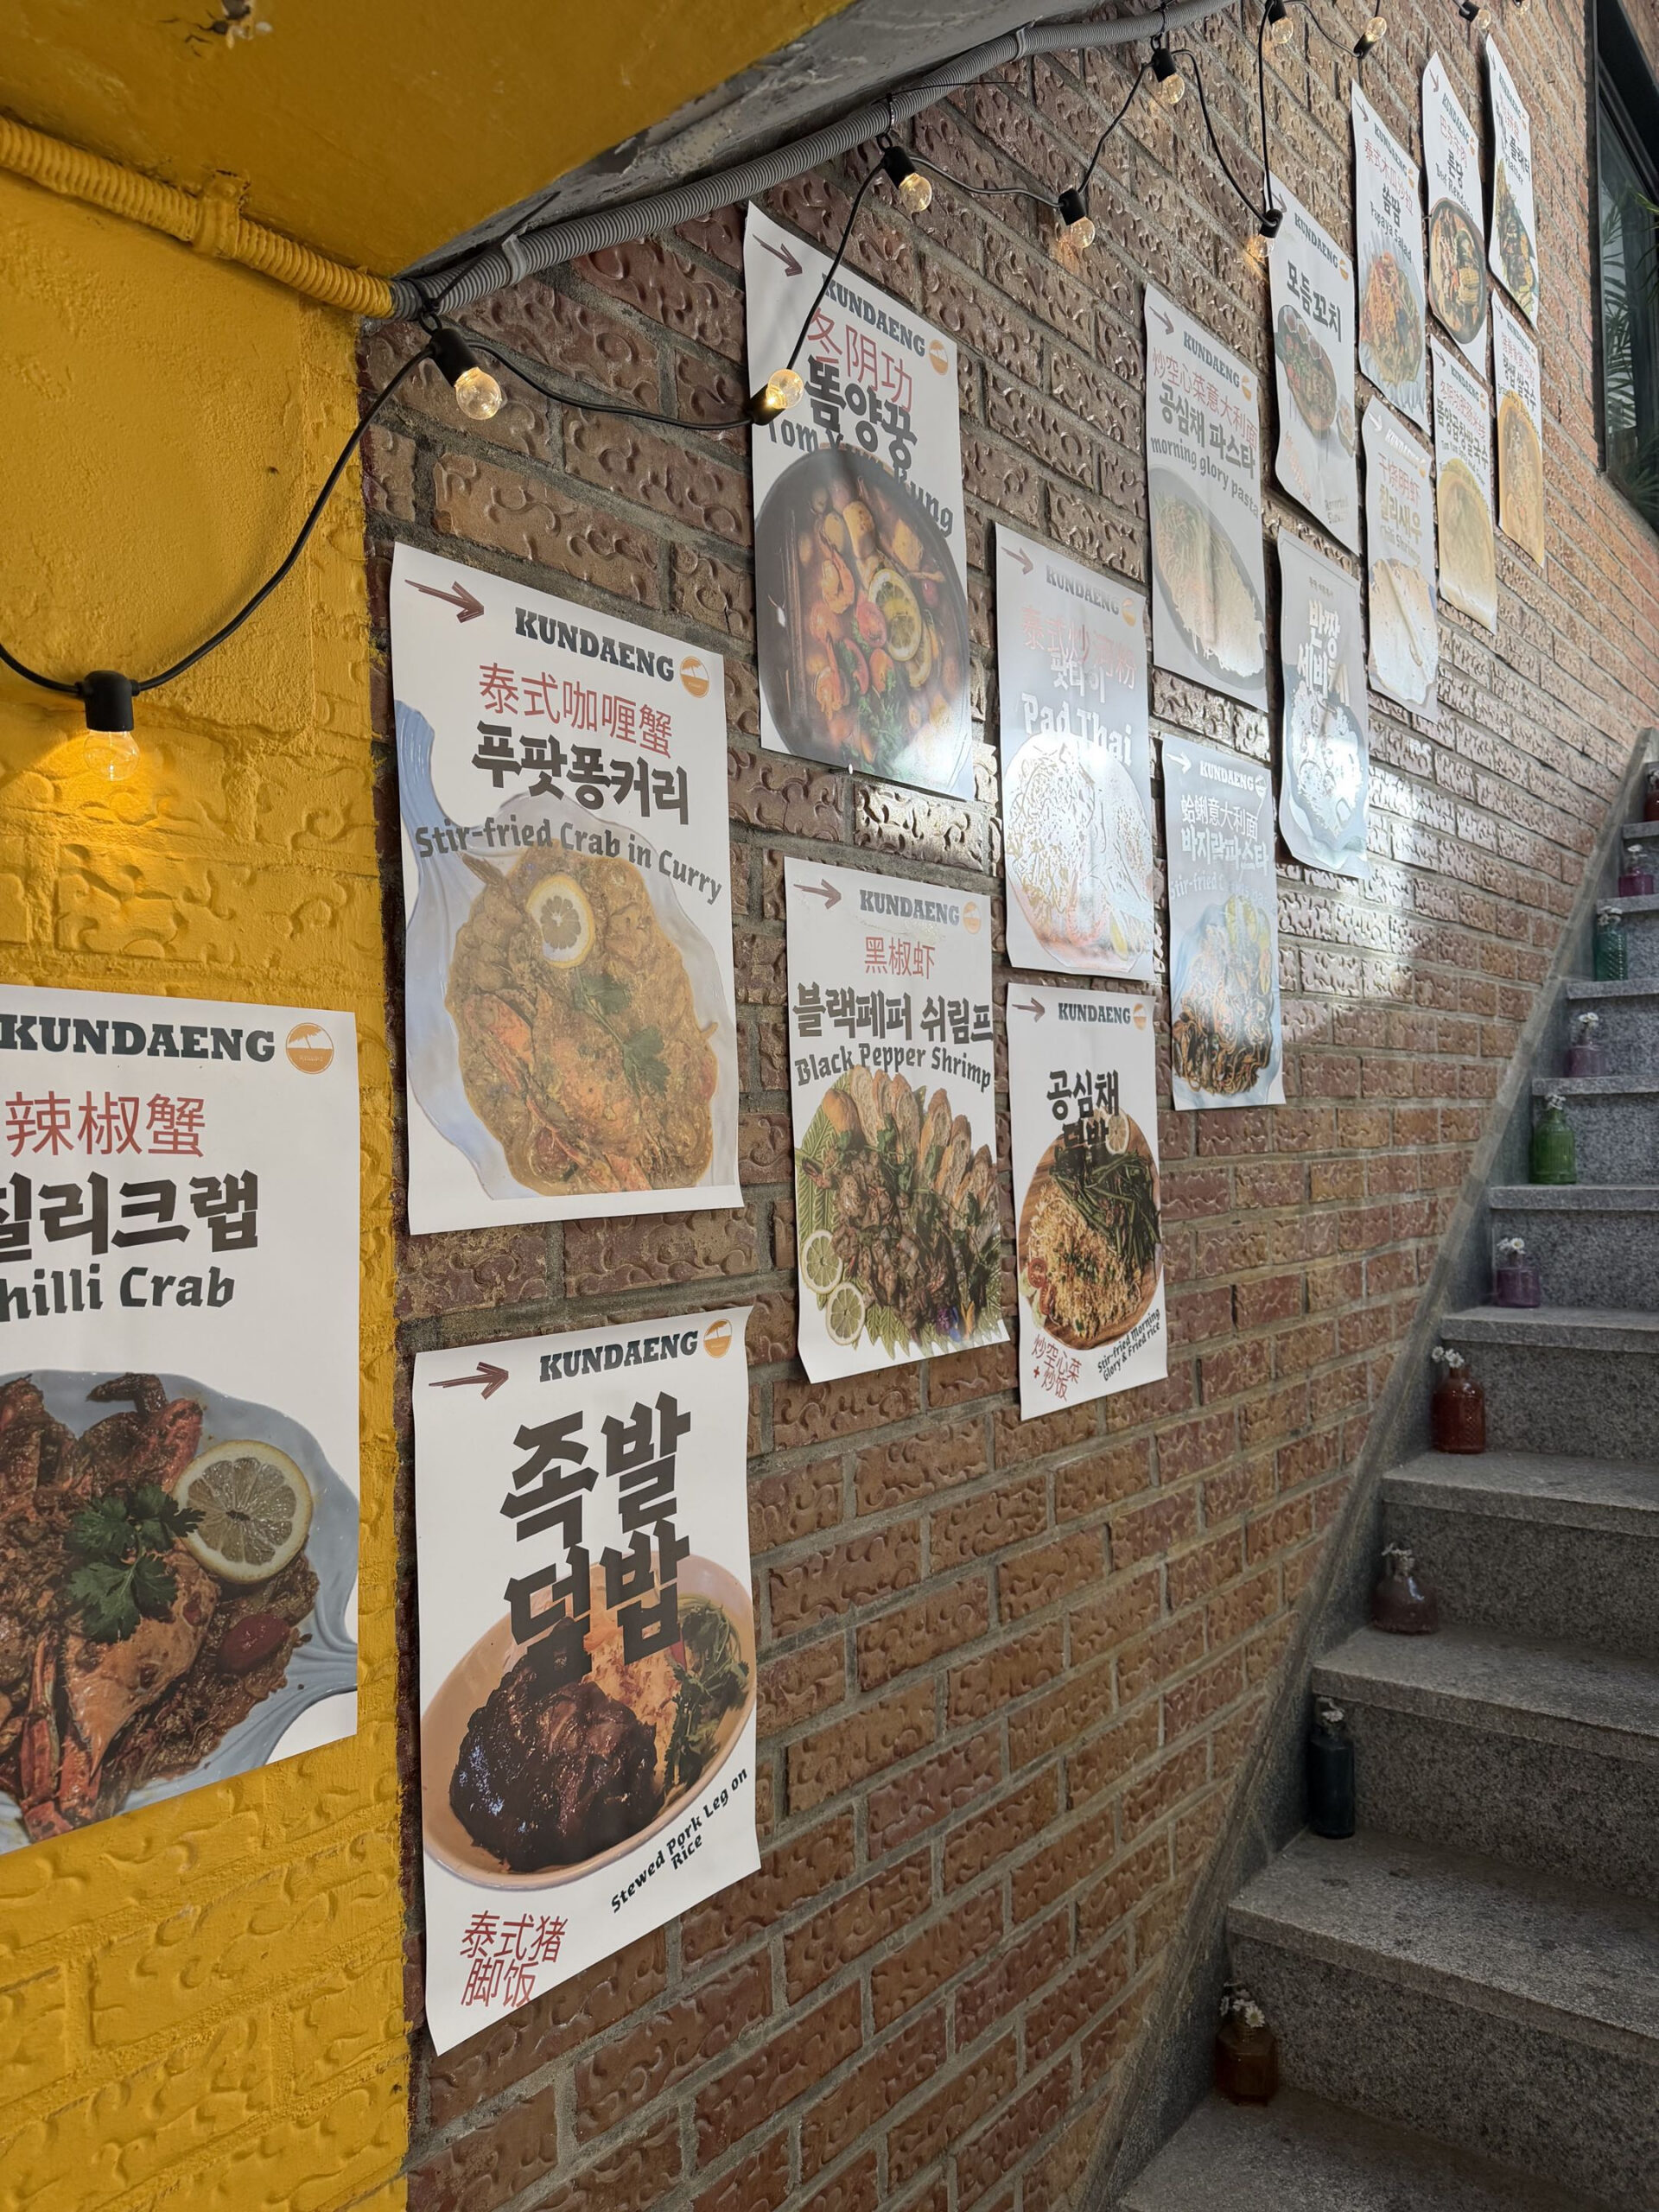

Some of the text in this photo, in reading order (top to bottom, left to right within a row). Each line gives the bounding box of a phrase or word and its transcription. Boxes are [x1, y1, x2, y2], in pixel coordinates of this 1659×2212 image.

[1370, 200, 1412, 264] Papaya Salad
[1382, 183, 1402, 228] 쏨땀
[1294, 212, 1338, 270] KUNDAENG
[822, 274, 925, 357] KUNDAENG
[1286, 258, 1342, 342] 모듬꼬치
[806, 307, 912, 412] 冬阴功
[1184, 331, 1240, 388] KUNDAENG
[804, 354, 918, 472] 똠양꿍
[1152, 347, 1258, 450] 炒空心菜意大利面
[1159, 381, 1205, 448] 공심채
[1210, 423, 1255, 480] 파스타
[1150, 435, 1259, 519] morning glory pasta
[1380, 484, 1422, 544] 칠리새우
[1046, 564, 1120, 615] KUNDAENG
[515, 607, 674, 682] KUNDAENG
[1020, 607, 1136, 689] 泰式炒河粉
[479, 662, 673, 759] 泰式咖喱蟹
[1021, 692, 1132, 766] Pad Thai
[472, 720, 690, 825] 푸팟퐁커리
[1199, 760, 1254, 791] KUNDAENG
[415, 814, 723, 906] Stir-fried Crab in Curry
[859, 889, 960, 926] KUNDAENG
[864, 936, 936, 979] 黑椒虾
[0, 1014, 276, 1063] KUNDAENG
[792, 981, 994, 1045] 블랙페퍼 쉬림프
[1058, 1002, 1131, 1025] KUNDAENG
[794, 1042, 992, 1093] Black Pepper Shrimp
[1046, 1069, 1119, 1122] 공심채
[5, 1090, 206, 1158] 辣椒蟹
[119, 1266, 235, 1308] Crab
[539, 1330, 699, 1382] KUNDAENG
[1031, 1333, 1082, 1384] 炒空心菜
[1097, 1332, 1135, 1373] Stir-fried
[1103, 1357, 1122, 1382] Glory
[1128, 1334, 1147, 1357] Fried
[1147, 1321, 1160, 1341] rice
[499, 1391, 691, 1549] 족발
[504, 1519, 690, 1680] 덮밥
[611, 1768, 747, 1913] Stewed Pork Leg on
[671, 1834, 703, 1871] Rice
[460, 1910, 569, 1963] 泰式猪
[460, 1957, 539, 2009] 脚饭
